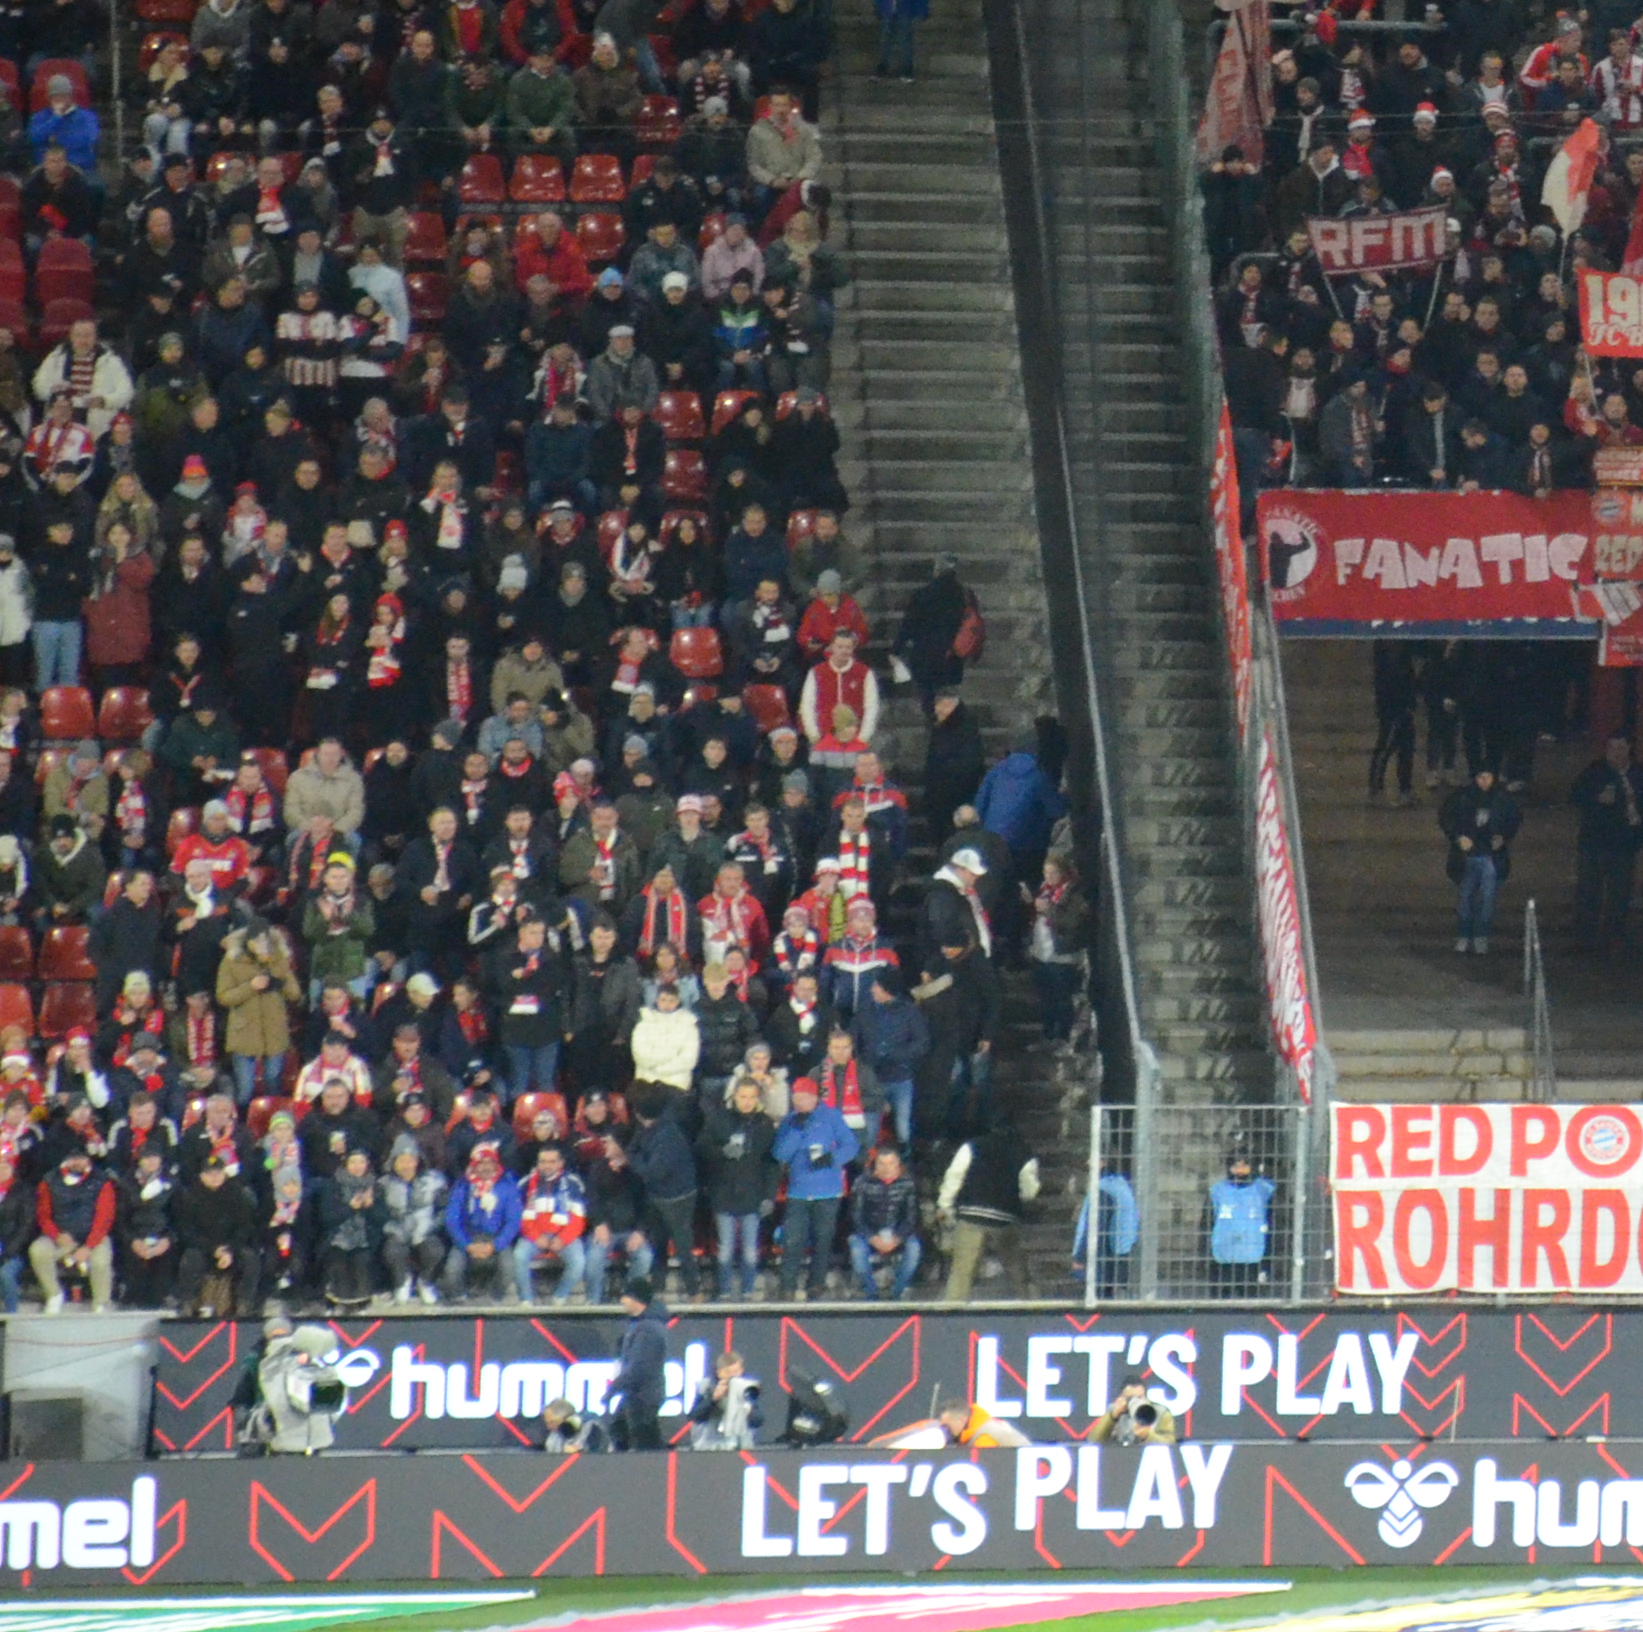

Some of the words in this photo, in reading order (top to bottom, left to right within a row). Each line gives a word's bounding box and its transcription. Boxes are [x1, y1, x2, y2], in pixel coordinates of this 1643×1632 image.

[1308, 211, 1447, 266] RFM
[1334, 533, 1588, 589] FANATIC
[1335, 1106, 1493, 1179] RED
[977, 1334, 1197, 1418] LET'S
[1222, 1334, 1419, 1415] PLAY
[741, 1464, 989, 1557] LET'S
[1014, 1445, 1234, 1530] PLAY
